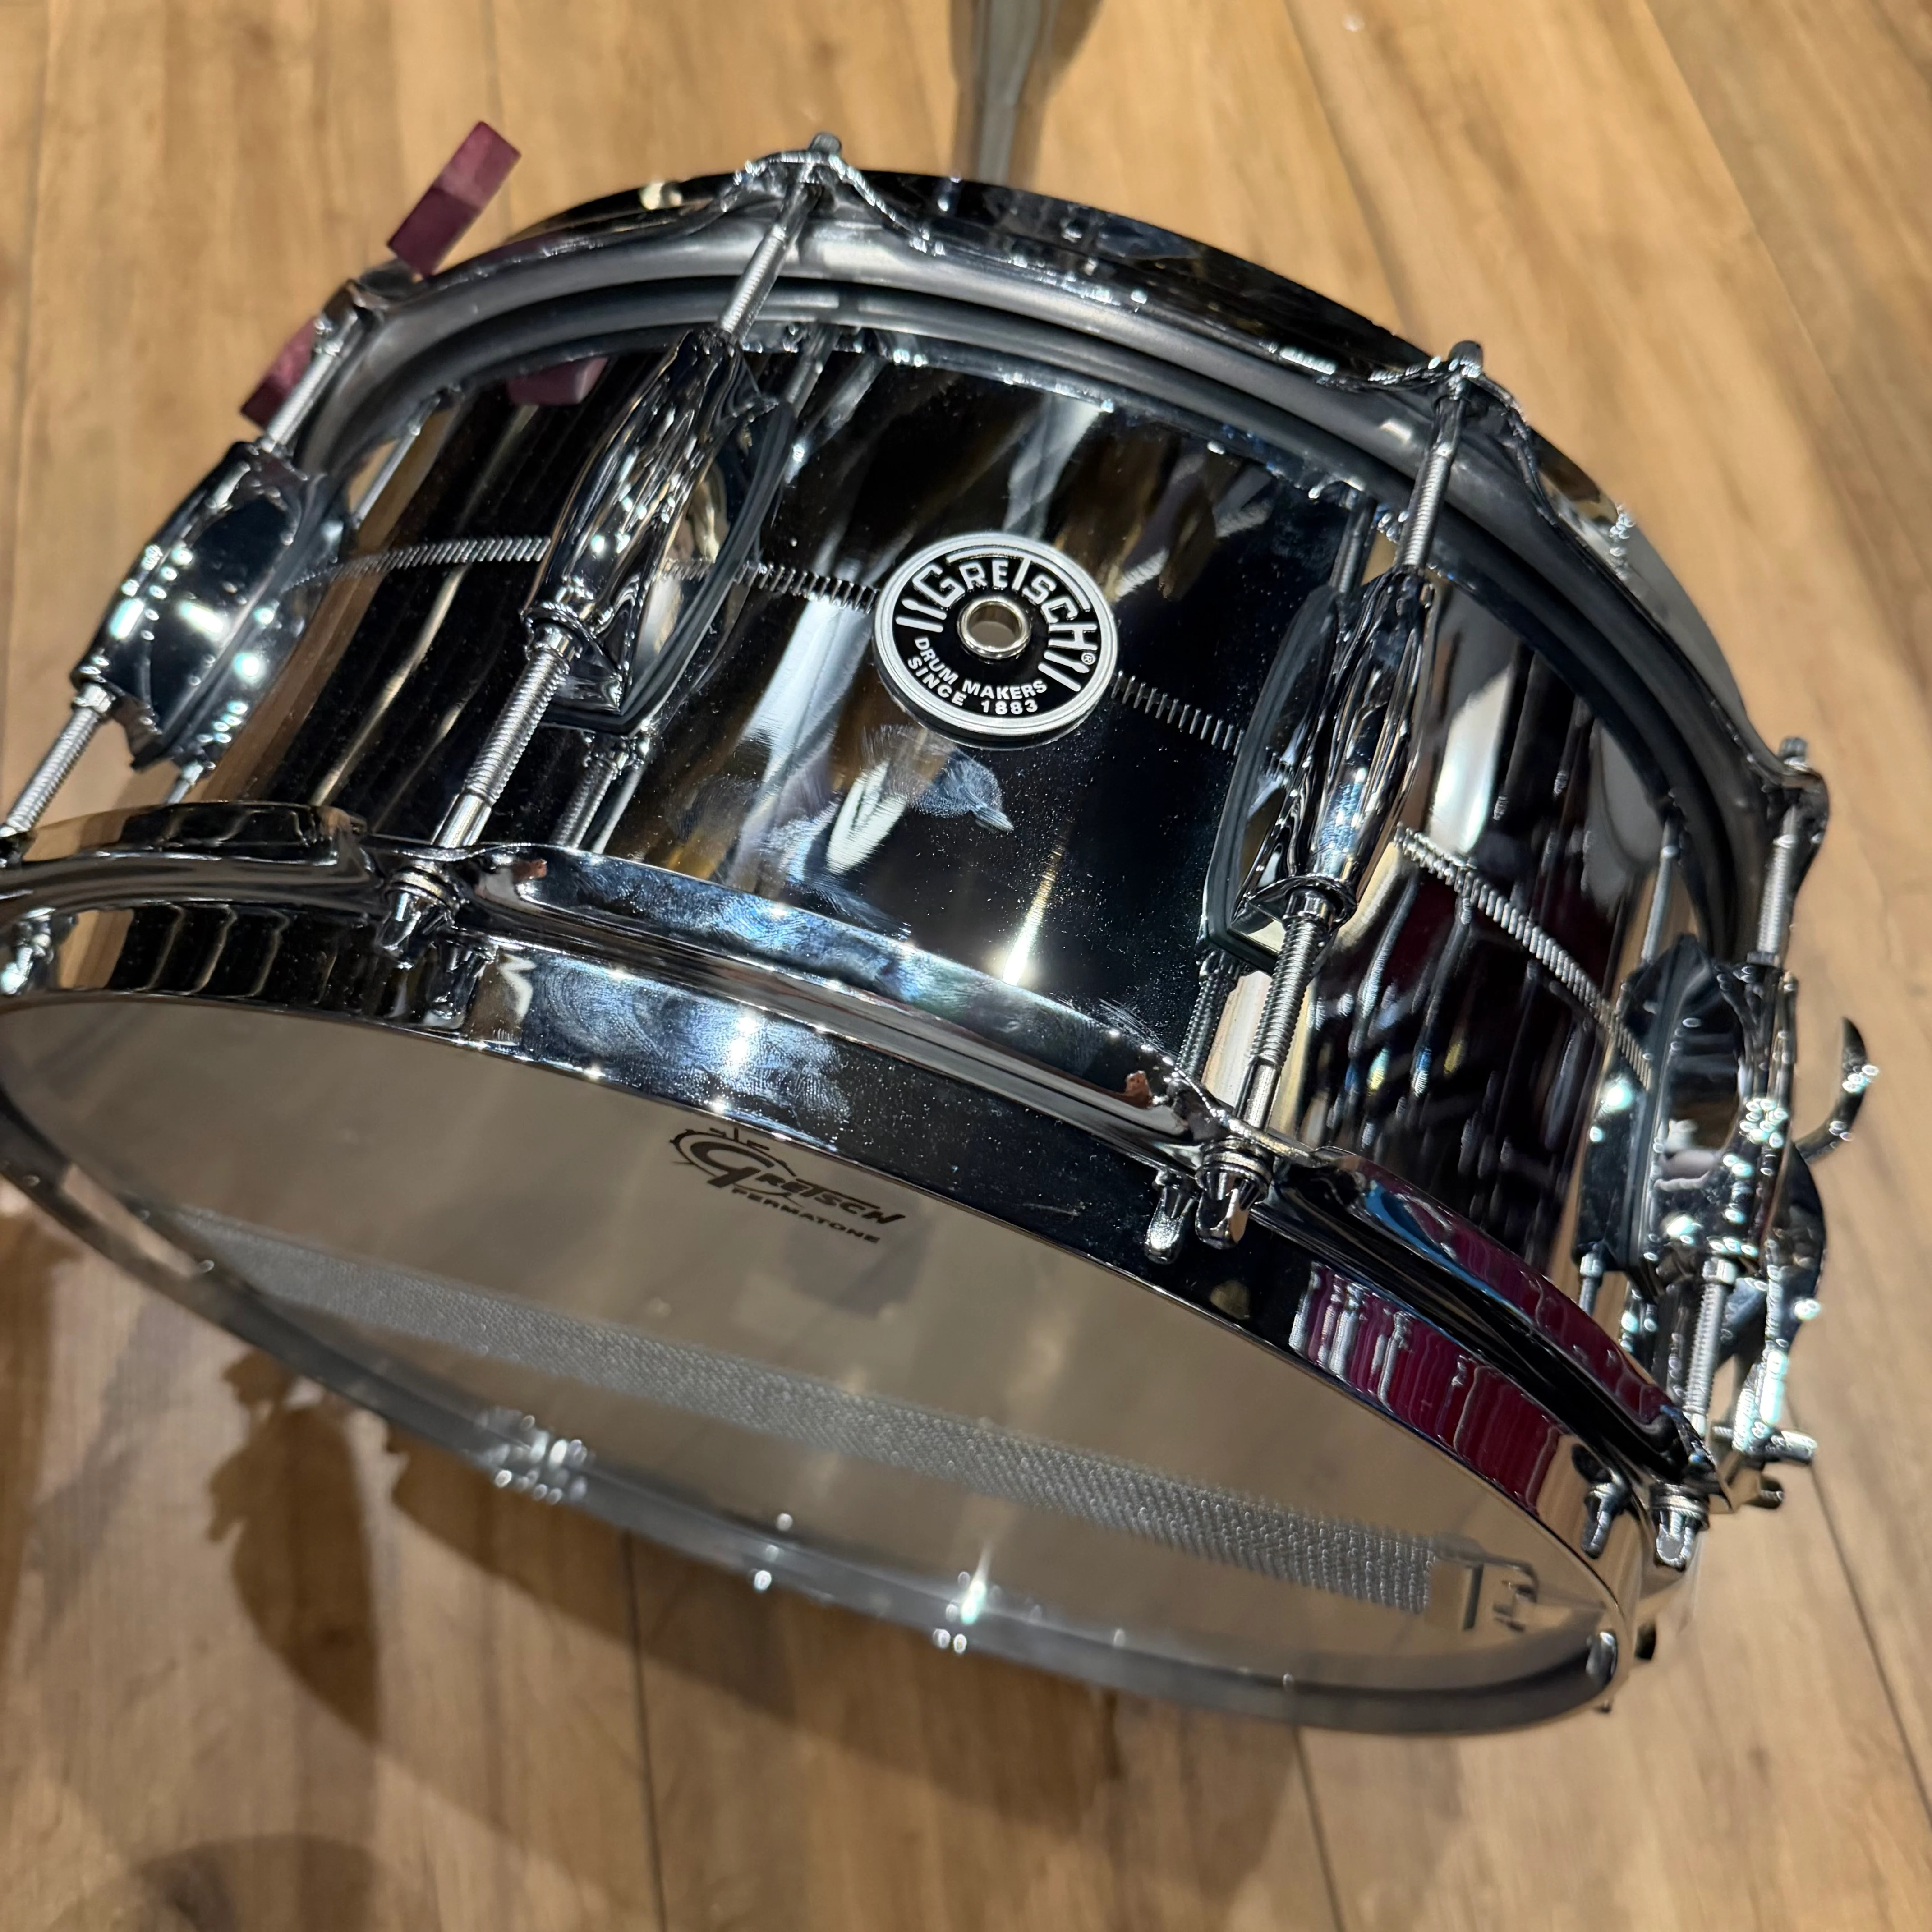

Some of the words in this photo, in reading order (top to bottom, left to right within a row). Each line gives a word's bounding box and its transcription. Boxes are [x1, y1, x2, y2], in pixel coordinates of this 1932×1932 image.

[912, 544, 1098, 651] GRETSCH
[907, 658, 967, 706] SINCE
[981, 699, 1038, 714] 1883
[914, 636, 959, 685] DRUM
[962, 679, 1048, 700] MAKERS
[731, 1187, 880, 1243] PERMATONE
